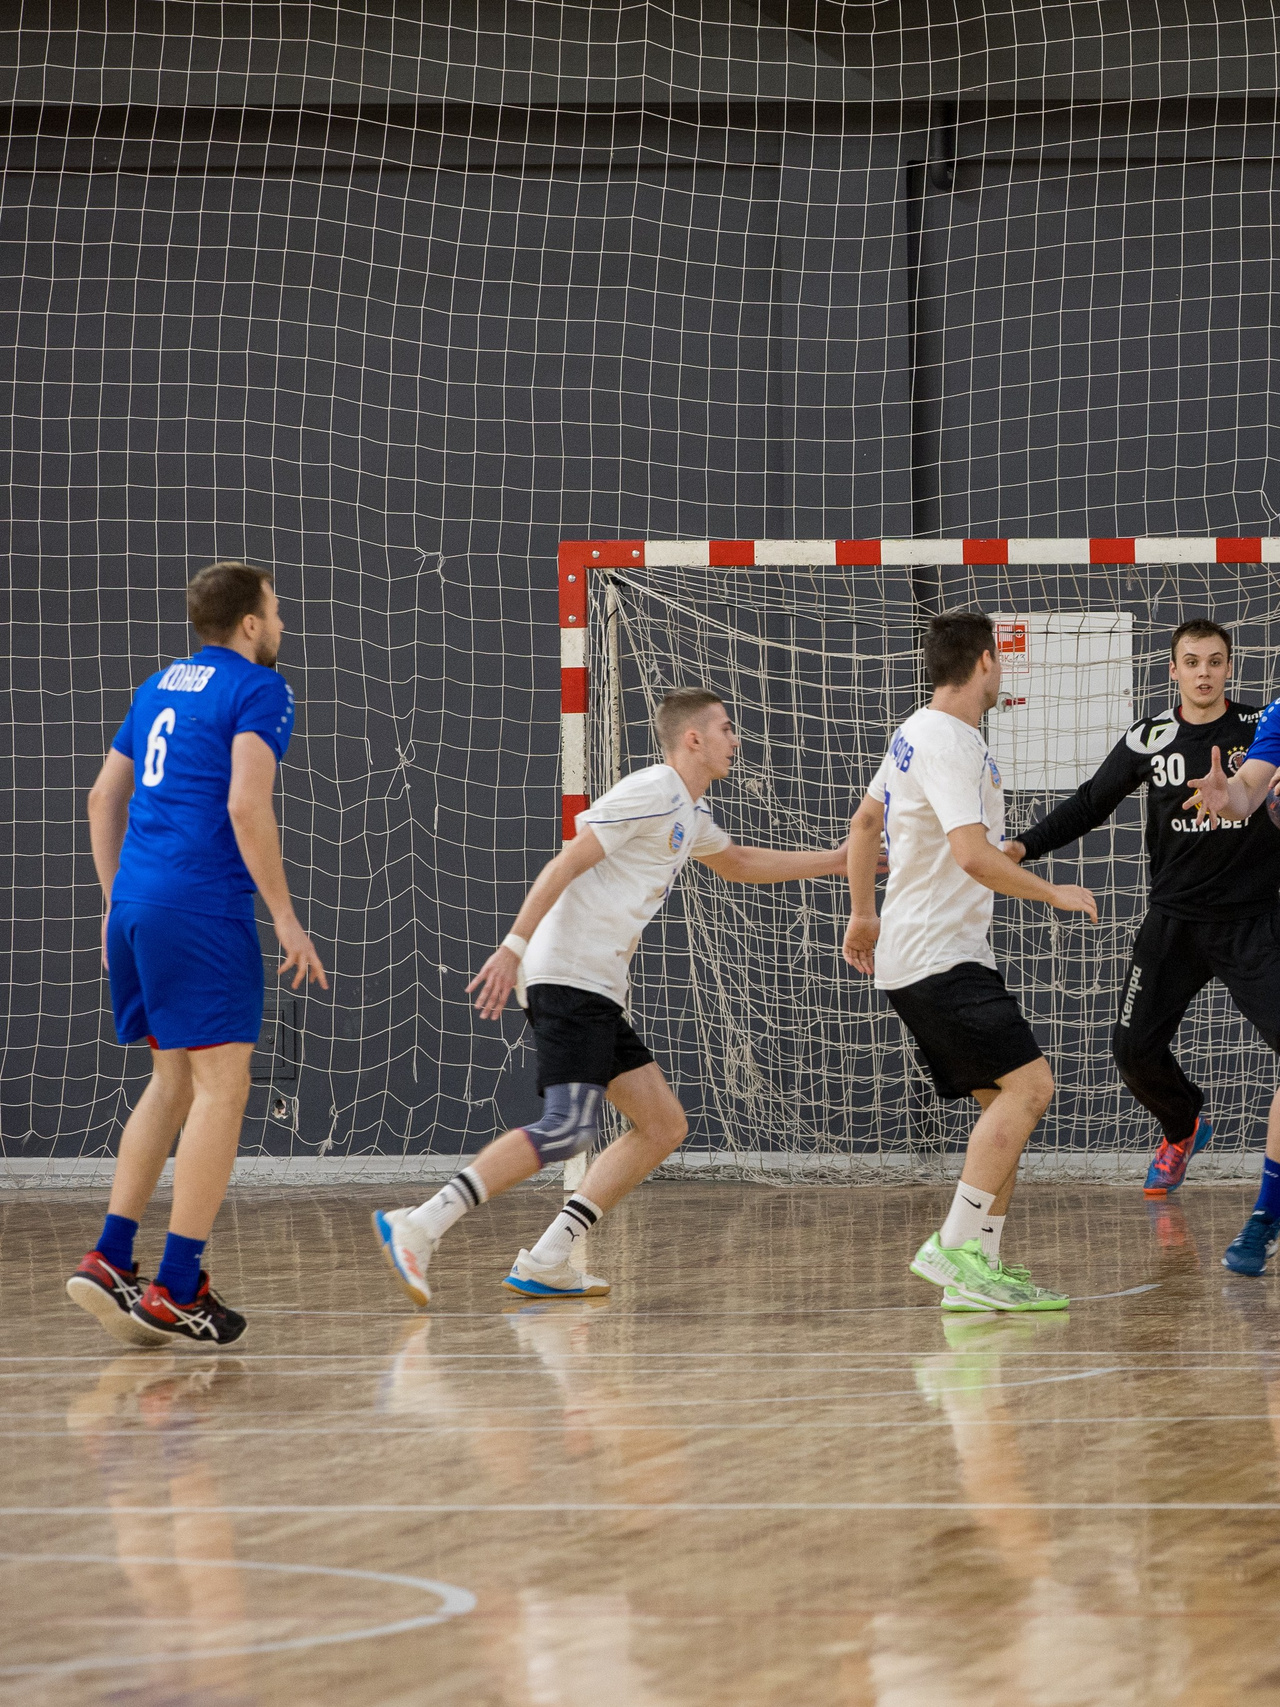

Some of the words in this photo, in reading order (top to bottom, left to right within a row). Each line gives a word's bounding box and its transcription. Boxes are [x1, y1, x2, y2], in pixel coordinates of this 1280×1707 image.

[157, 663, 216, 692] КОНЕВ
[142, 707, 176, 787] 6
[1151, 752, 1186, 787] 30
